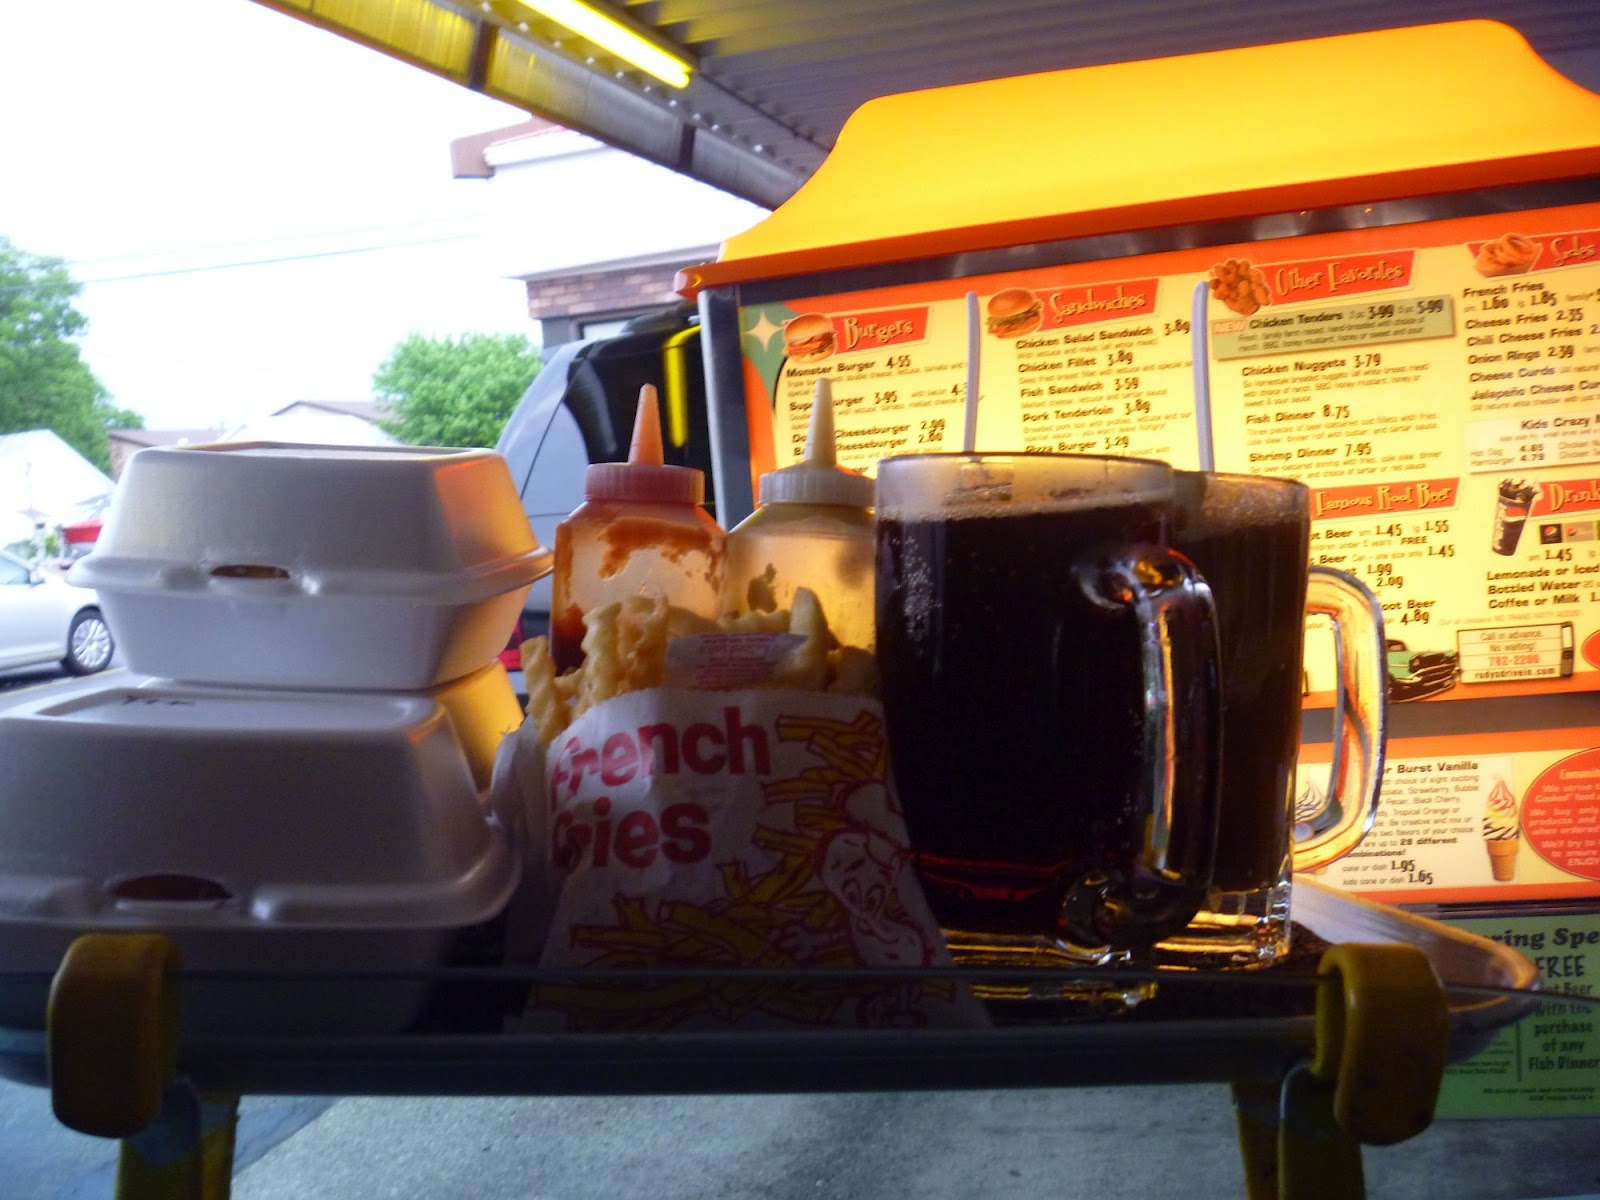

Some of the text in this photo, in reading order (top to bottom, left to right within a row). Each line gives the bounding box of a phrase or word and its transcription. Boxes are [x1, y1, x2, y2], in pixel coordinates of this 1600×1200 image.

[1276, 260, 1403, 296] Other Favorites
[1463, 281, 1545, 298] French Fries
[1050, 286, 1146, 323] Sandwiches
[1250, 317, 1294, 329] Chicken
[1298, 310, 1344, 324] Tenders
[1465, 319, 1511, 329] Cheese
[1516, 314, 1548, 324] Fries
[843, 317, 914, 350] Burgers
[1015, 338, 1059, 349] Chicken
[1064, 333, 1095, 344] Salad
[1100, 327, 1154, 341] Sandwich
[1499, 332, 1545, 343] Cheese
[1550, 328, 1582, 338] Fries
[1468, 353, 1502, 365] Onion
[1506, 350, 1540, 362] Rings
[786, 365, 832, 378] Monster
[838, 360, 876, 373] Burger
[1018, 362, 1063, 373] Chicken
[1242, 364, 1289, 377] Chicken
[1294, 358, 1346, 372] Nuggets
[1469, 366, 1555, 382] Cheese Curds
[1020, 387, 1044, 398] Fish
[1048, 382, 1103, 394] Sandwich
[1530, 384, 1575, 395] Cheese
[1022, 411, 1049, 422] Pork
[1054, 405, 1114, 419] Tenderloin
[1246, 414, 1270, 424] Fish
[1275, 410, 1316, 422] Dinner
[1553, 417, 1590, 428] Crazy
[1058, 441, 1097, 451] Burger
[1249, 450, 1292, 462] Shrimp
[1298, 446, 1337, 458] Dinner
[1326, 529, 1352, 539] Beer
[1401, 536, 1427, 545] FREE
[1319, 554, 1347, 564] Beer
[1487, 563, 1600, 581] Lemonade or Iced
[1488, 580, 1581, 595] Bottled Water
[1407, 600, 1436, 609] Beer
[1488, 593, 1580, 608] Coffee or Milk
[1397, 764, 1432, 774] Burst
[1437, 761, 1479, 771] Vanilla
[1416, 837, 1458, 845] different
[1488, 928, 1545, 950] ring
[1535, 954, 1585, 978] FREE
[1535, 1020, 1593, 1038] purchase
[1528, 1055, 1555, 1070] Fish
[1557, 1055, 1600, 1070] Dinner
